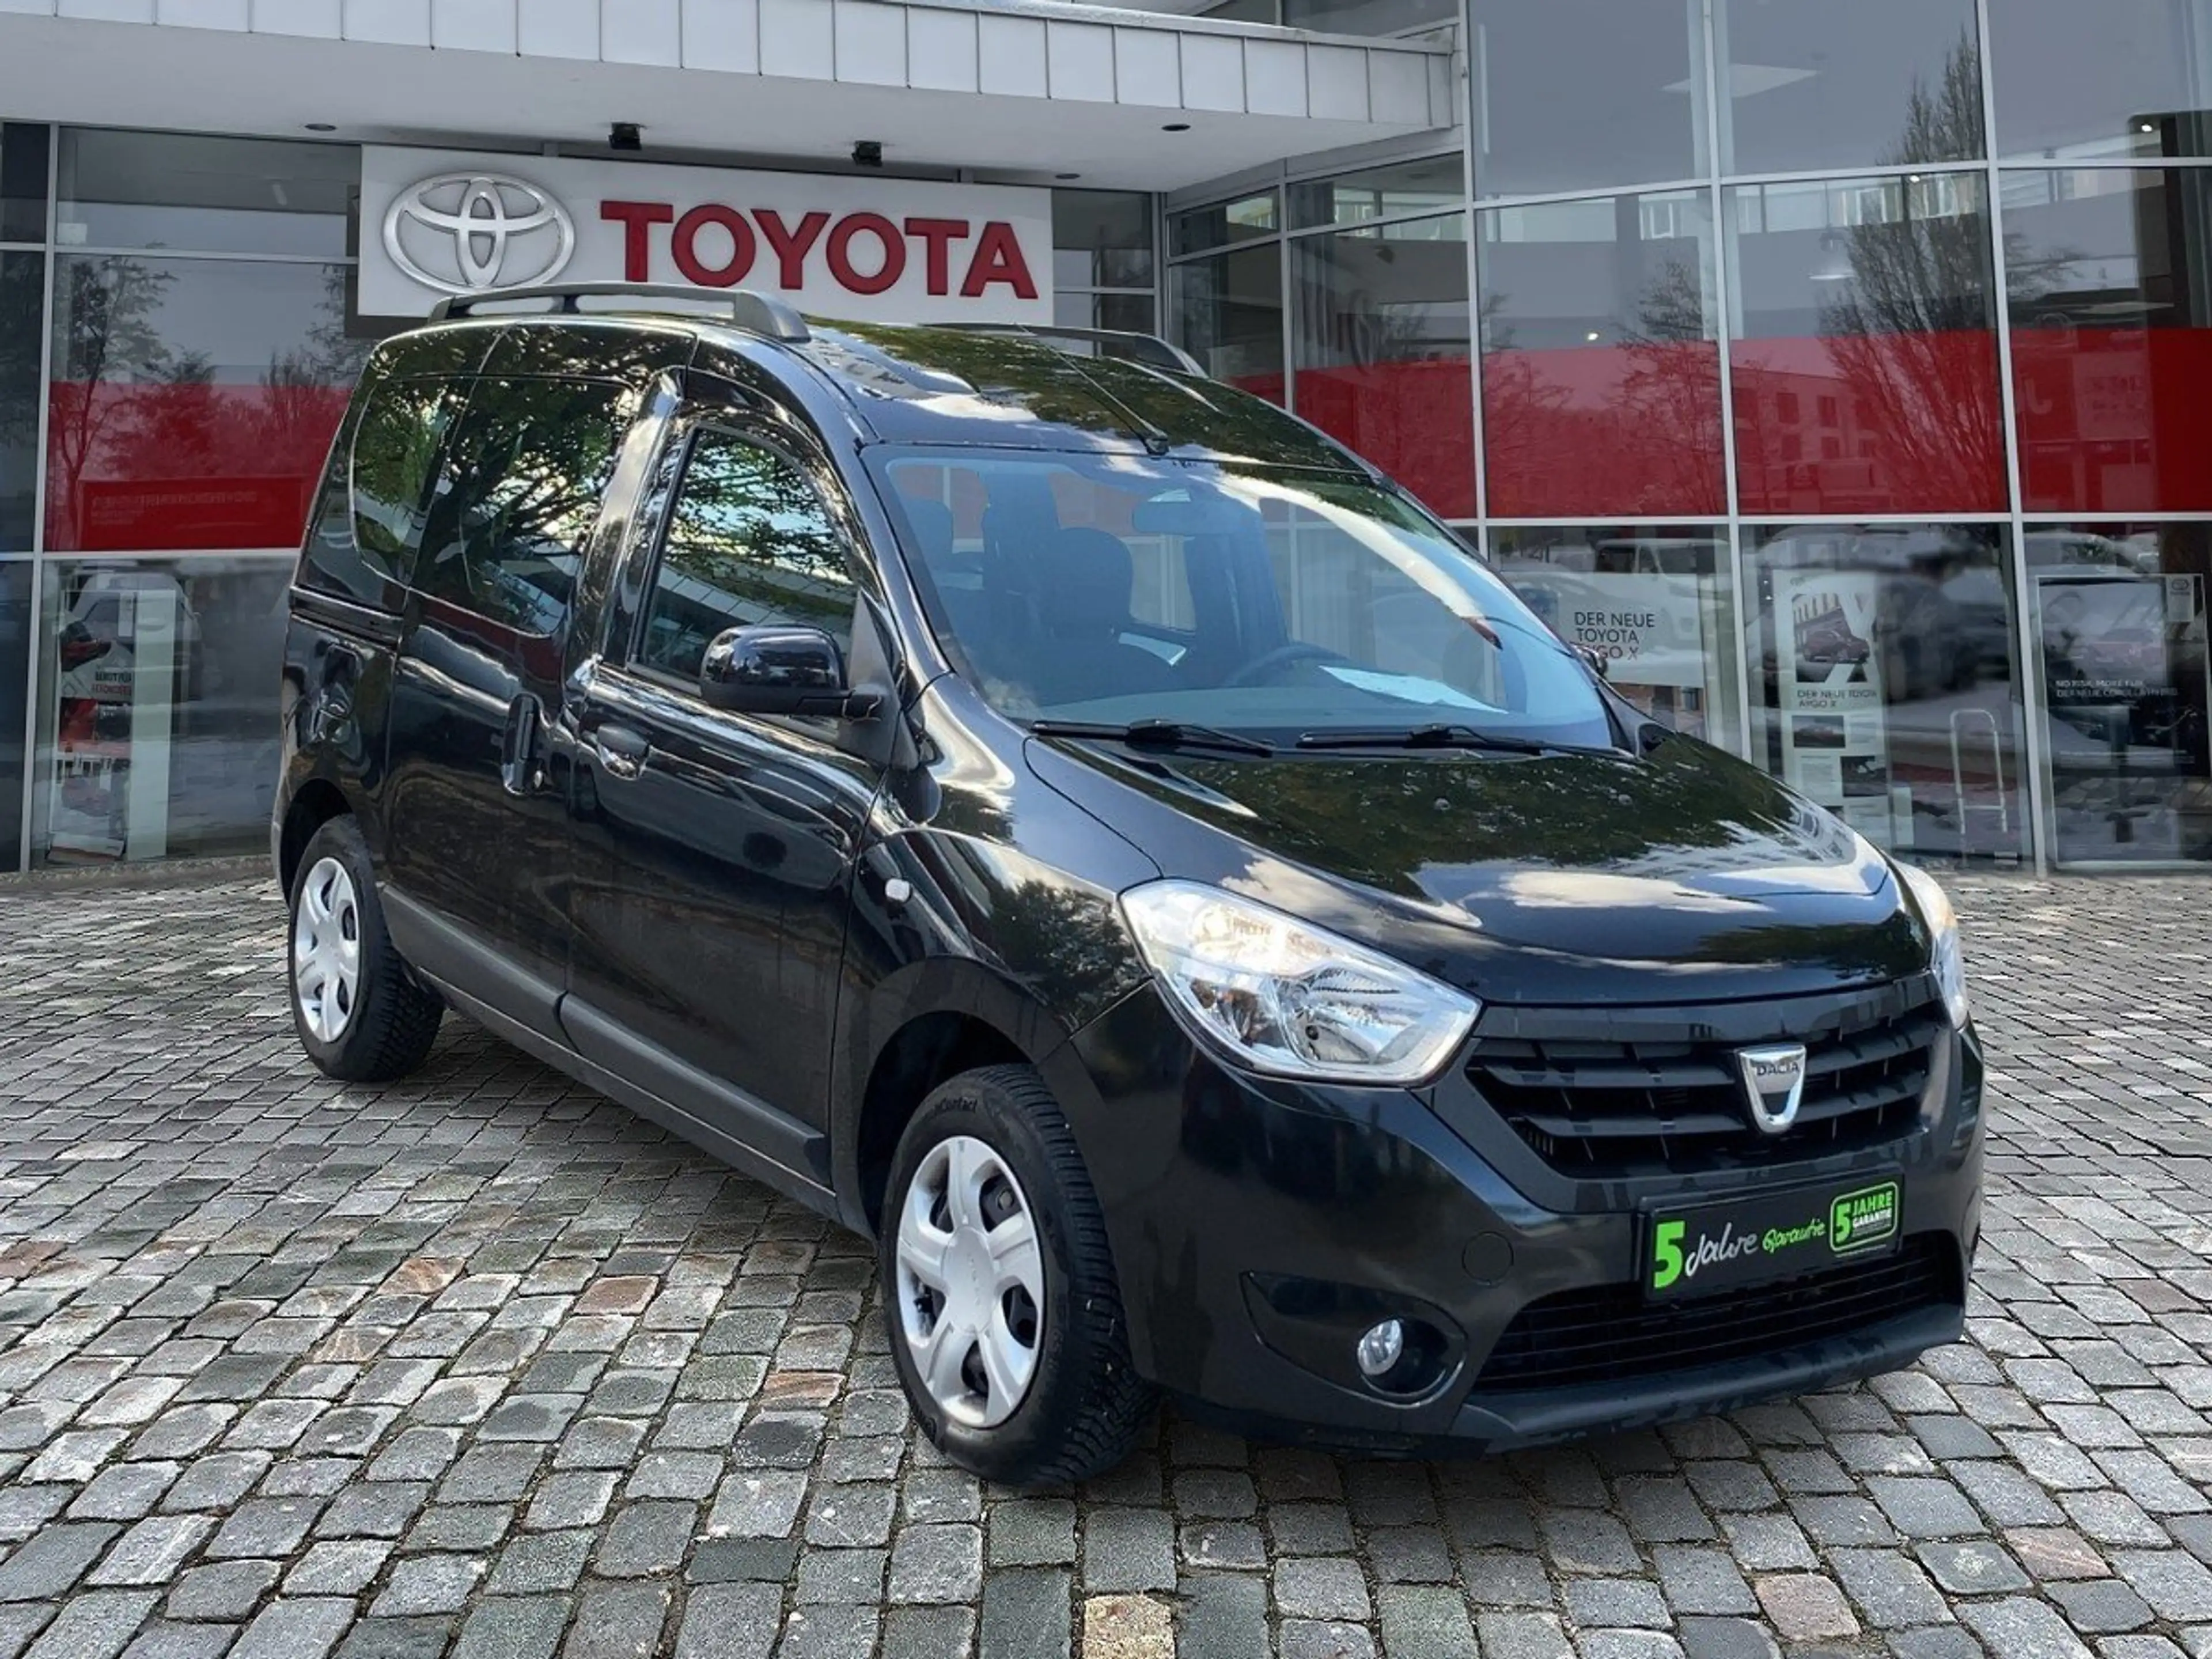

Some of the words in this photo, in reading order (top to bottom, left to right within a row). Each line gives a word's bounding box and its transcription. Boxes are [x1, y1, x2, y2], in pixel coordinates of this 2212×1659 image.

[601, 200, 1038, 300] TOYOTA
[1574, 612, 1607, 626] DER
[1611, 613, 1655, 627] NEUE
[1576, 628, 1639, 644] TOYOTA
[1628, 646, 1639, 660] X
[1756, 1062, 1799, 1075] DACIA
[1836, 1203, 1851, 1243] 5
[1853, 1191, 1892, 1216] JAHRE
[1654, 1220, 1685, 1289] 5
[1685, 1222, 1758, 1277] Jahre
